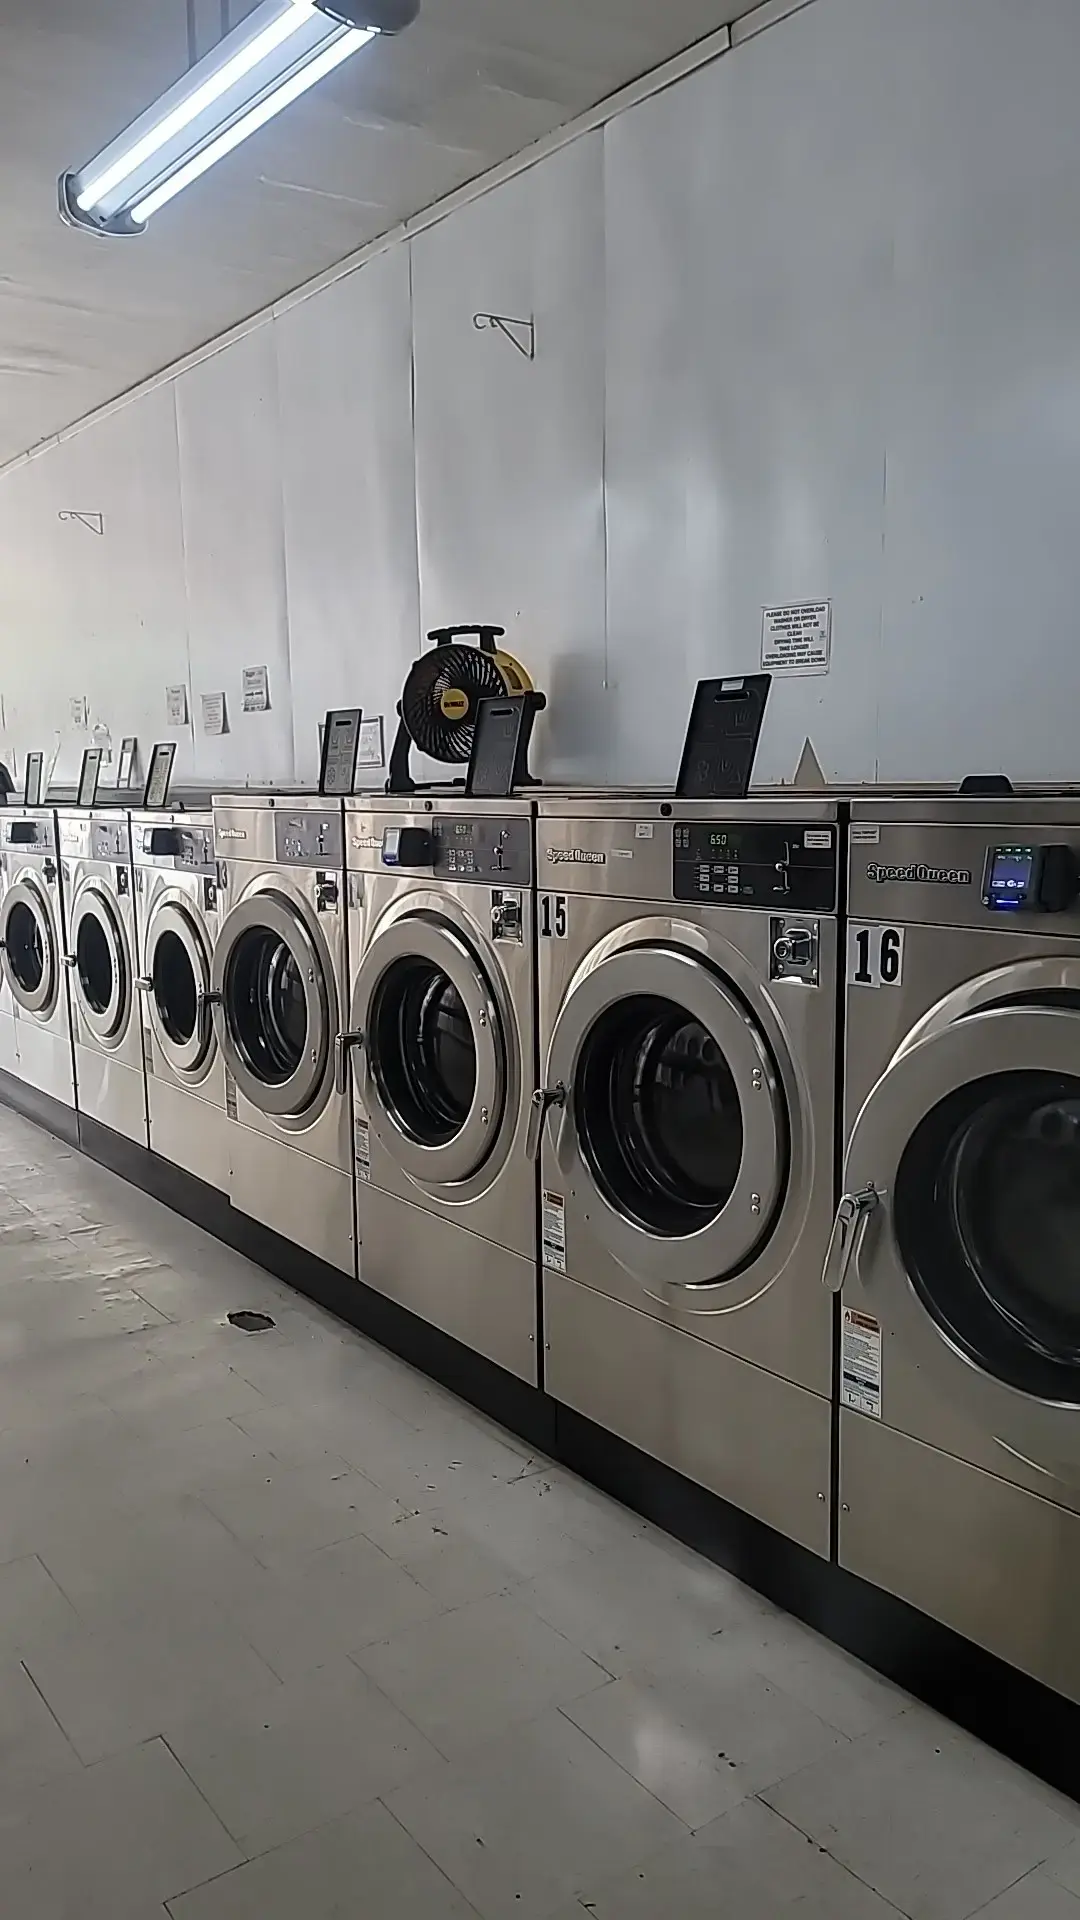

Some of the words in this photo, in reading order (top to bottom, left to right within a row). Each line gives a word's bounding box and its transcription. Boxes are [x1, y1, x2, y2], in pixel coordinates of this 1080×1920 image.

[801, 606, 825, 614] OVERLOAD
[541, 896, 566, 937] 15
[855, 929, 901, 983] 16
